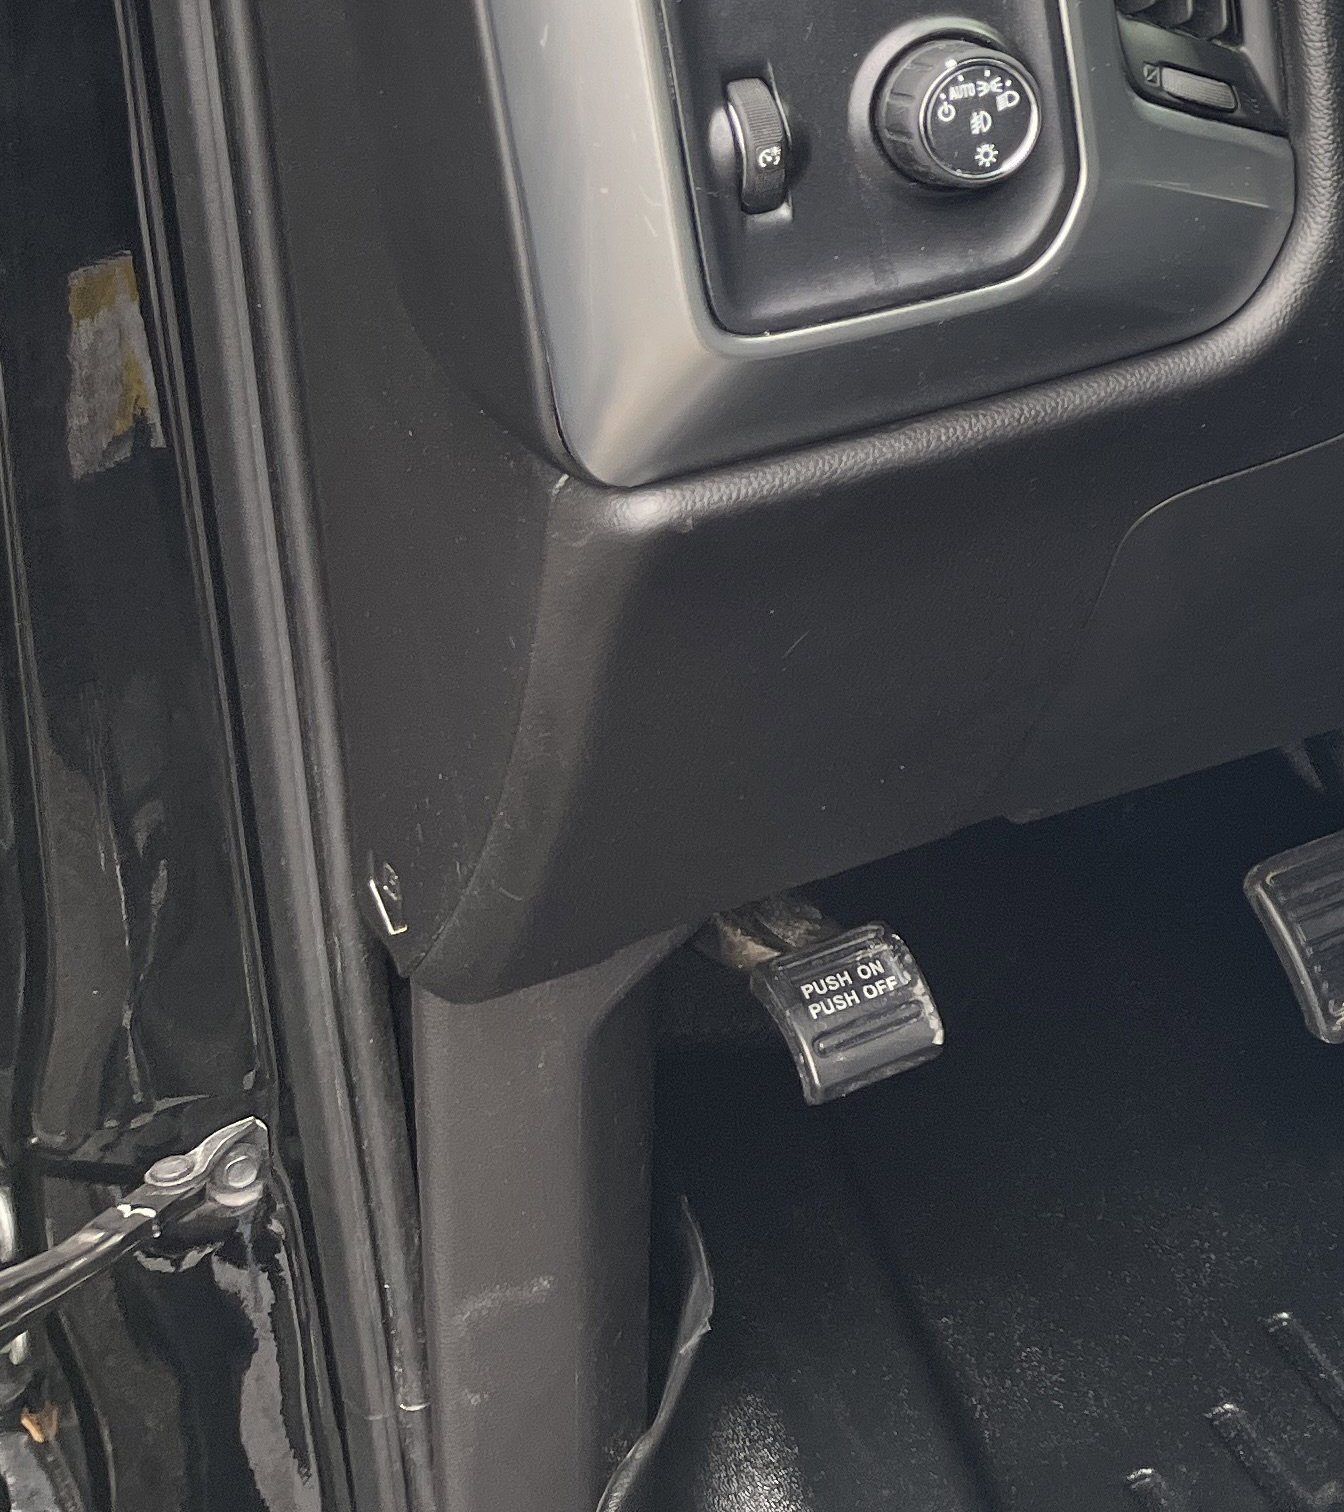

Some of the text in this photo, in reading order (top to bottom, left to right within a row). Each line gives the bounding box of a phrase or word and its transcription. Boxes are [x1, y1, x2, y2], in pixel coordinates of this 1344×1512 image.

[949, 82, 976, 100] AUTO
[800, 959, 885, 1000] PUSH ON
[808, 976, 898, 1020] PUSH OFF
